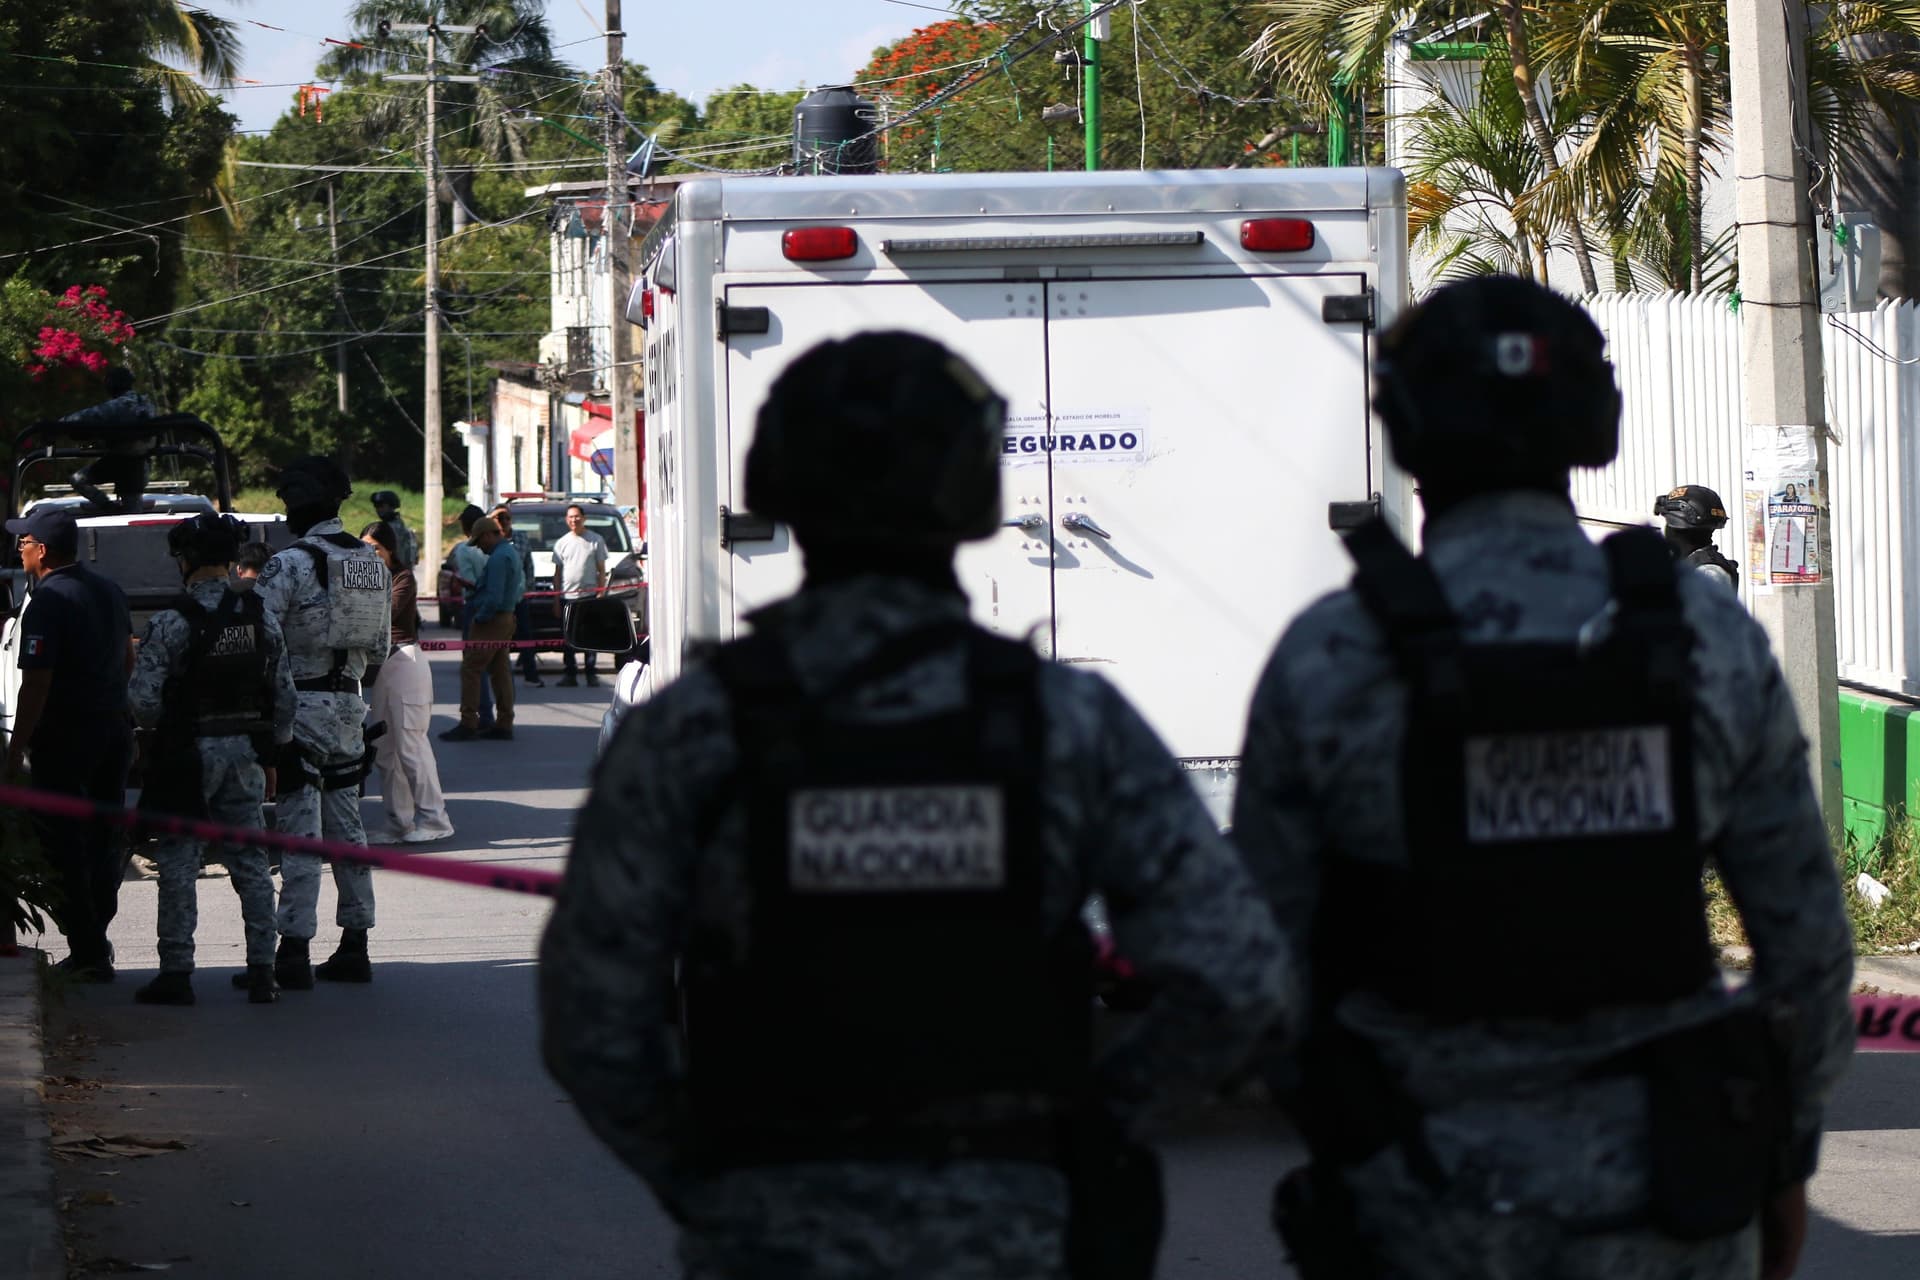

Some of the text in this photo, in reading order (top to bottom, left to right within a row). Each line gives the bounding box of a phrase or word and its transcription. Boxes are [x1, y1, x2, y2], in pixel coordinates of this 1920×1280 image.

[1002, 432, 1138, 454] EGURADO
[346, 574, 382, 589] NACIONAL
[347, 560, 380, 575] GUARDIA
[1486, 735, 1650, 784] GUARDIA
[803, 795, 990, 837] GUARDIA
[1472, 783, 1665, 832] NACIONAL
[799, 842, 995, 881] NACIONAL
